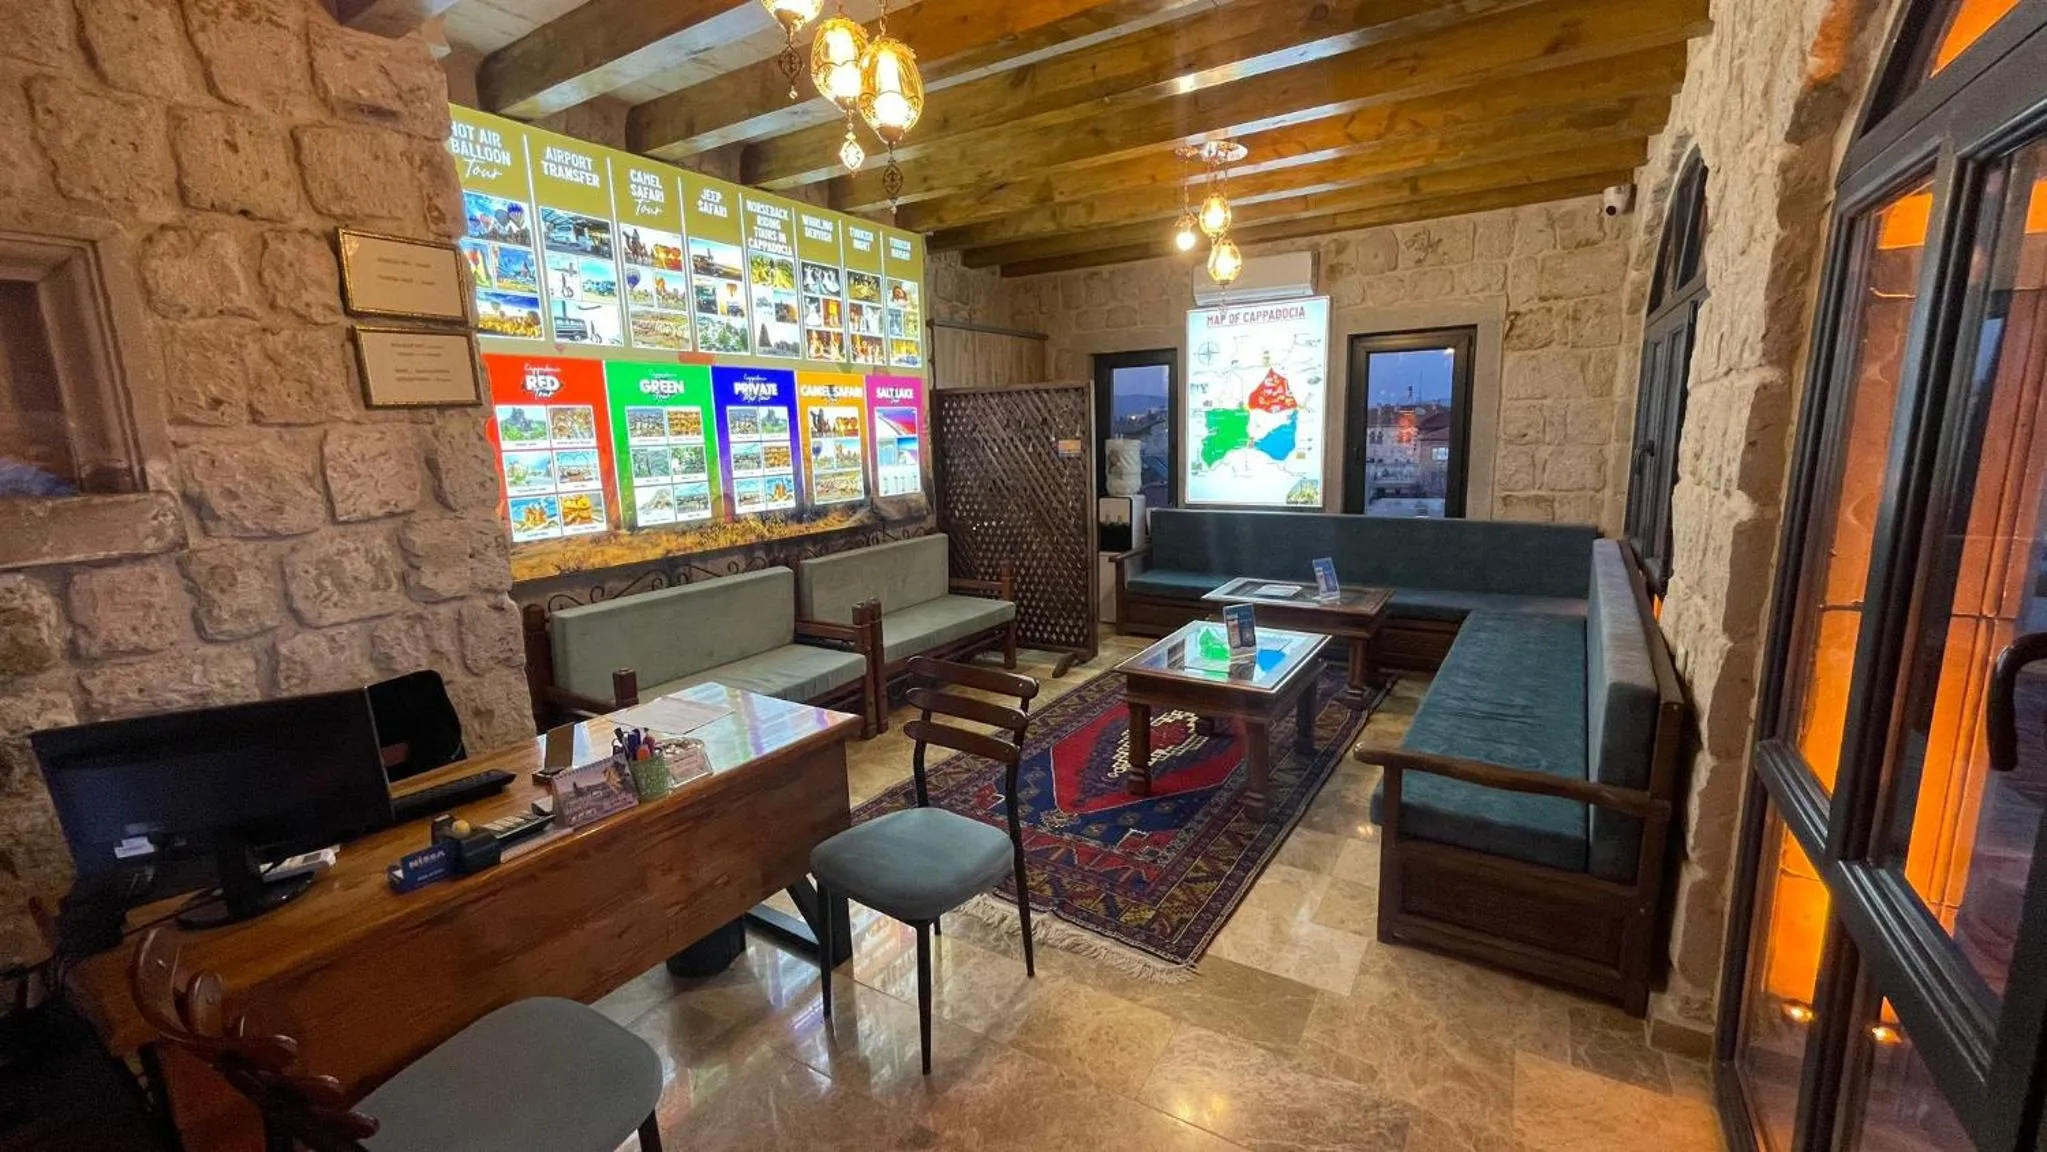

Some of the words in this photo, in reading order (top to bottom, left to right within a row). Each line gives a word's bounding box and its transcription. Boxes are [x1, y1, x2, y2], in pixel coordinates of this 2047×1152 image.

[480, 132, 501, 148] AIR
[450, 138, 511, 166] BALLOON
[545, 146, 593, 170] AIRPORT
[464, 158, 503, 181] Tour
[541, 160, 600, 188] TRANSFER
[629, 169, 662, 189] CAMEL
[630, 183, 664, 203] SAFARI
[701, 188, 723, 203] JEEP
[635, 199, 662, 216] Tour
[698, 200, 728, 218] SAFARI
[746, 200, 789, 221] HORSEBACK
[1206, 313, 1226, 327] MAP
[1229, 311, 1241, 324] OF
[1243, 305, 1305, 323] CAPPADOCIA
[525, 374, 560, 391] RED
[639, 379, 685, 394] GREEN
[733, 381, 778, 396] PRIVATE
[800, 385, 830, 398] CAMEL
[831, 386, 864, 399] SAFARI
[876, 387, 894, 399] SALT
[895, 388, 914, 400] LAKE
